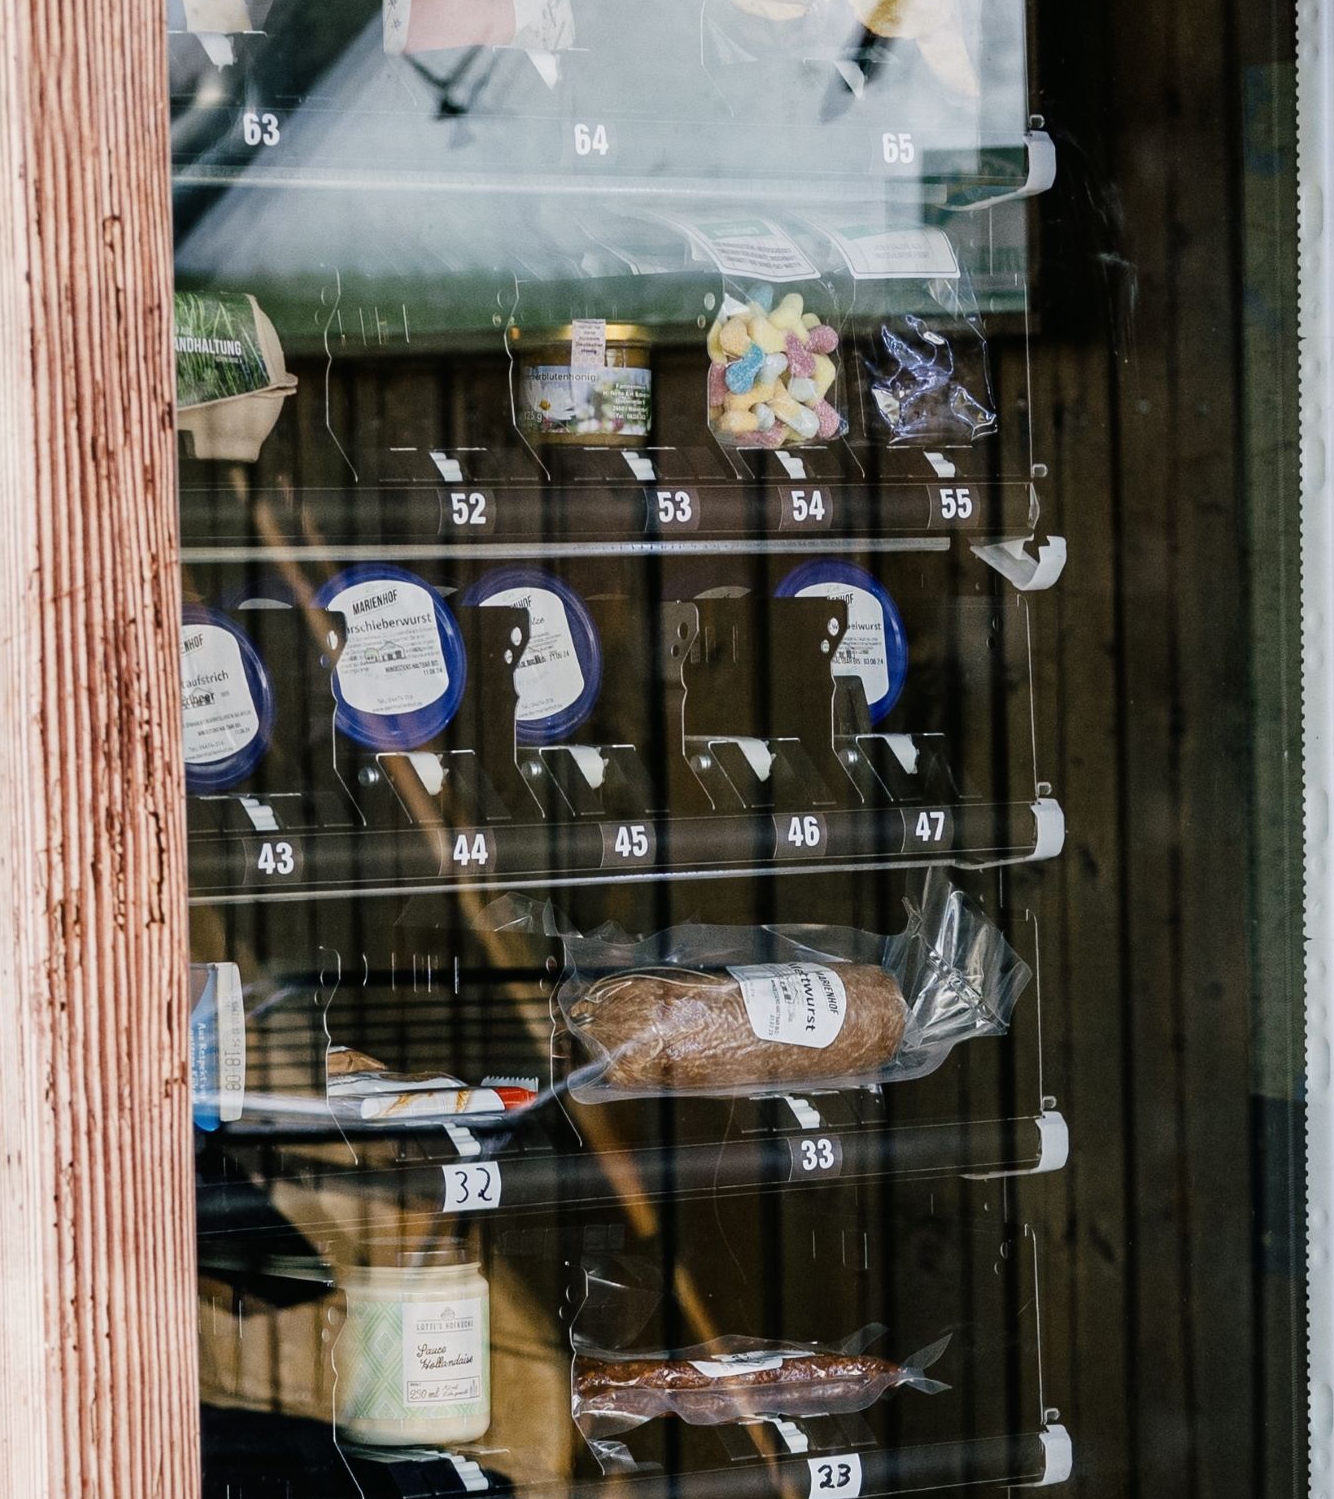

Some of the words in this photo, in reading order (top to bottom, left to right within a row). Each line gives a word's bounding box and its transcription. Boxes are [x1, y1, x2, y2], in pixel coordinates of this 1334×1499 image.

[243, 113, 280, 146] 63
[574, 124, 609, 155] 64
[882, 133, 914, 163] 65
[451, 493, 486, 524] 52
[658, 491, 692, 523] 53
[791, 490, 825, 522] 54
[940, 488, 973, 519] 55
[352, 589, 398, 615] MARIENHOF
[614, 825, 649, 857] 45
[788, 816, 820, 847] 46
[916, 811, 945, 841] 47
[258, 842, 294, 874] 43
[453, 834, 488, 865] 44
[801, 1138, 835, 1171] 33
[454, 1168, 493, 1203] 32
